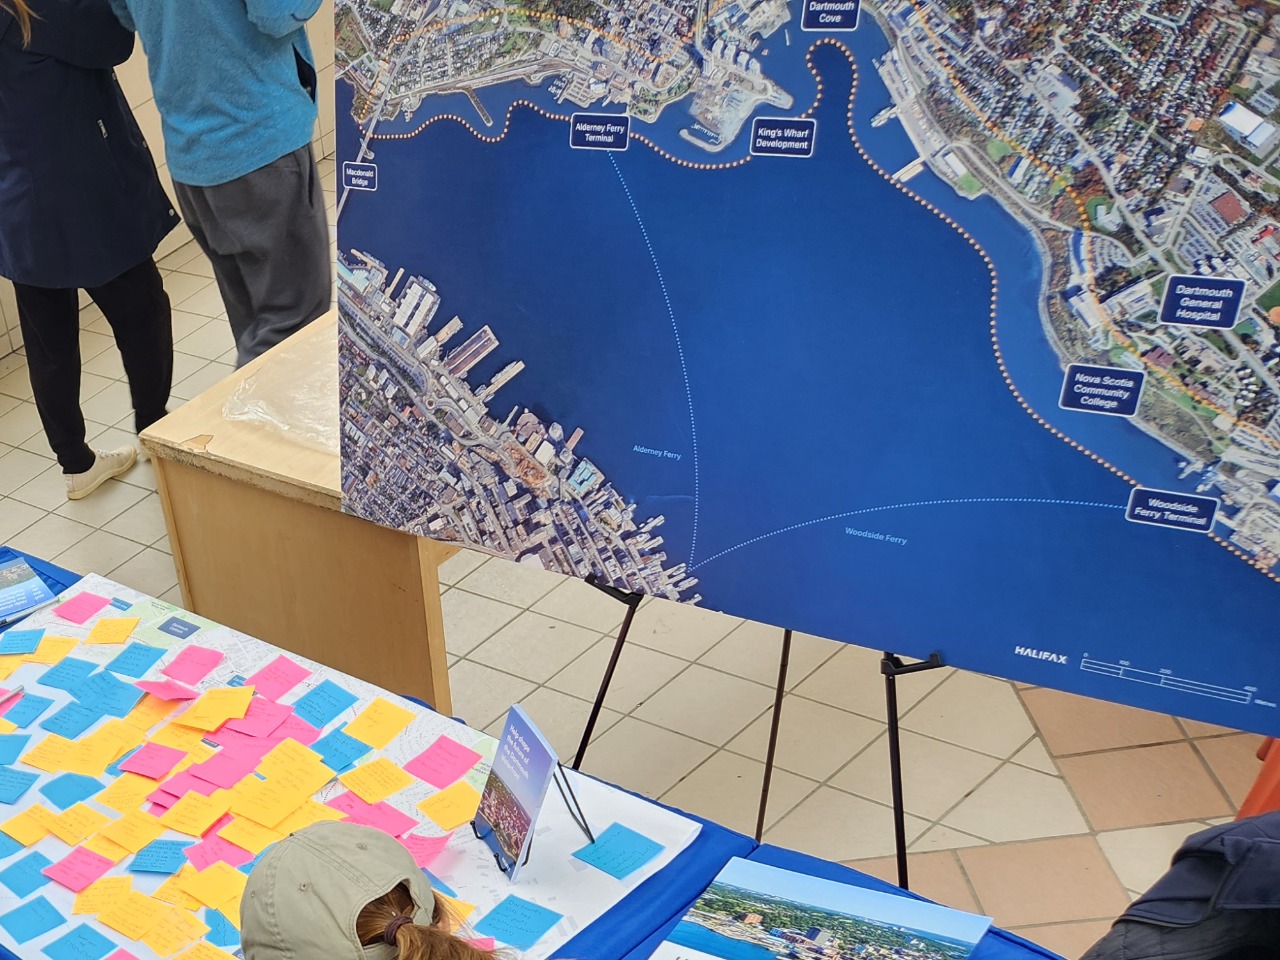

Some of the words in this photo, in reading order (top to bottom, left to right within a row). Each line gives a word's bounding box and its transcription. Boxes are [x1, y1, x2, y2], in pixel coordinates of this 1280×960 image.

[810, 2, 855, 11] Dartmouth
[820, 14, 842, 23] Cove
[575, 123, 604, 134] Alderney
[606, 124, 625, 135] Ferry
[758, 128, 782, 138] King's
[784, 129, 809, 138] Wharf
[585, 134, 614, 143] Terminal
[756, 139, 808, 150] Development
[346, 168, 374, 178] Macdonald
[351, 177, 369, 187] Bridge
[1175, 284, 1233, 298] Dartmouth
[1180, 298, 1223, 309] General
[1175, 309, 1221, 322] Hospital
[1075, 373, 1101, 384] Nova
[1102, 376, 1134, 388] Scotia
[1074, 384, 1130, 400] Community
[1080, 396, 1119, 409] College
[633, 445, 663, 458] Alderney
[664, 450, 681, 461] Ferry
[1148, 498, 1199, 514] Woodside
[1134, 507, 1162, 520] Ferry
[1163, 511, 1207, 526] Terminal
[845, 527, 884, 541] Woodside
[886, 533, 908, 546] Ferry
[1014, 645, 1068, 665] HALIFAX
